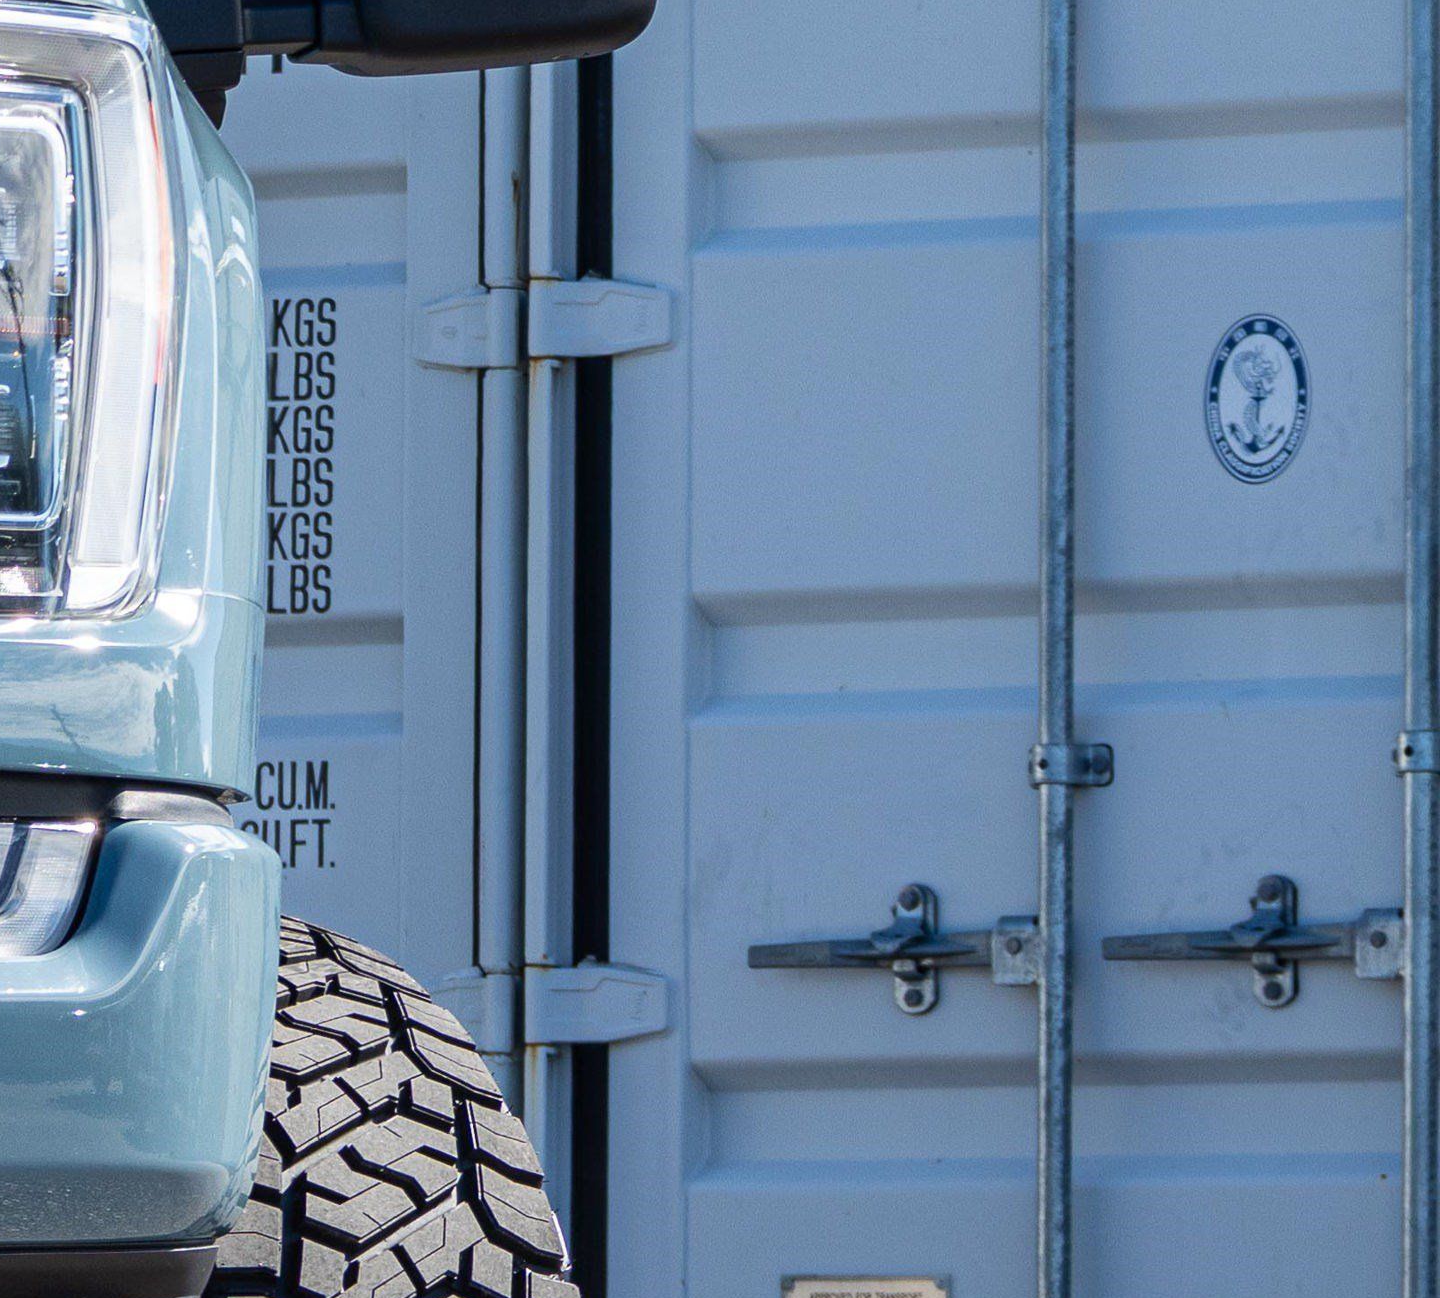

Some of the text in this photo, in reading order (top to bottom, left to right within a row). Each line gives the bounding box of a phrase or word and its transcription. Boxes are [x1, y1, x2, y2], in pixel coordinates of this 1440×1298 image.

[271, 298, 336, 347] KGS
[267, 352, 336, 401] LBS
[267, 405, 335, 454] KGS
[266, 458, 334, 508] LBS
[268, 512, 333, 561] KGS
[266, 565, 332, 614] LBS
[255, 760, 335, 810] CU.M.
